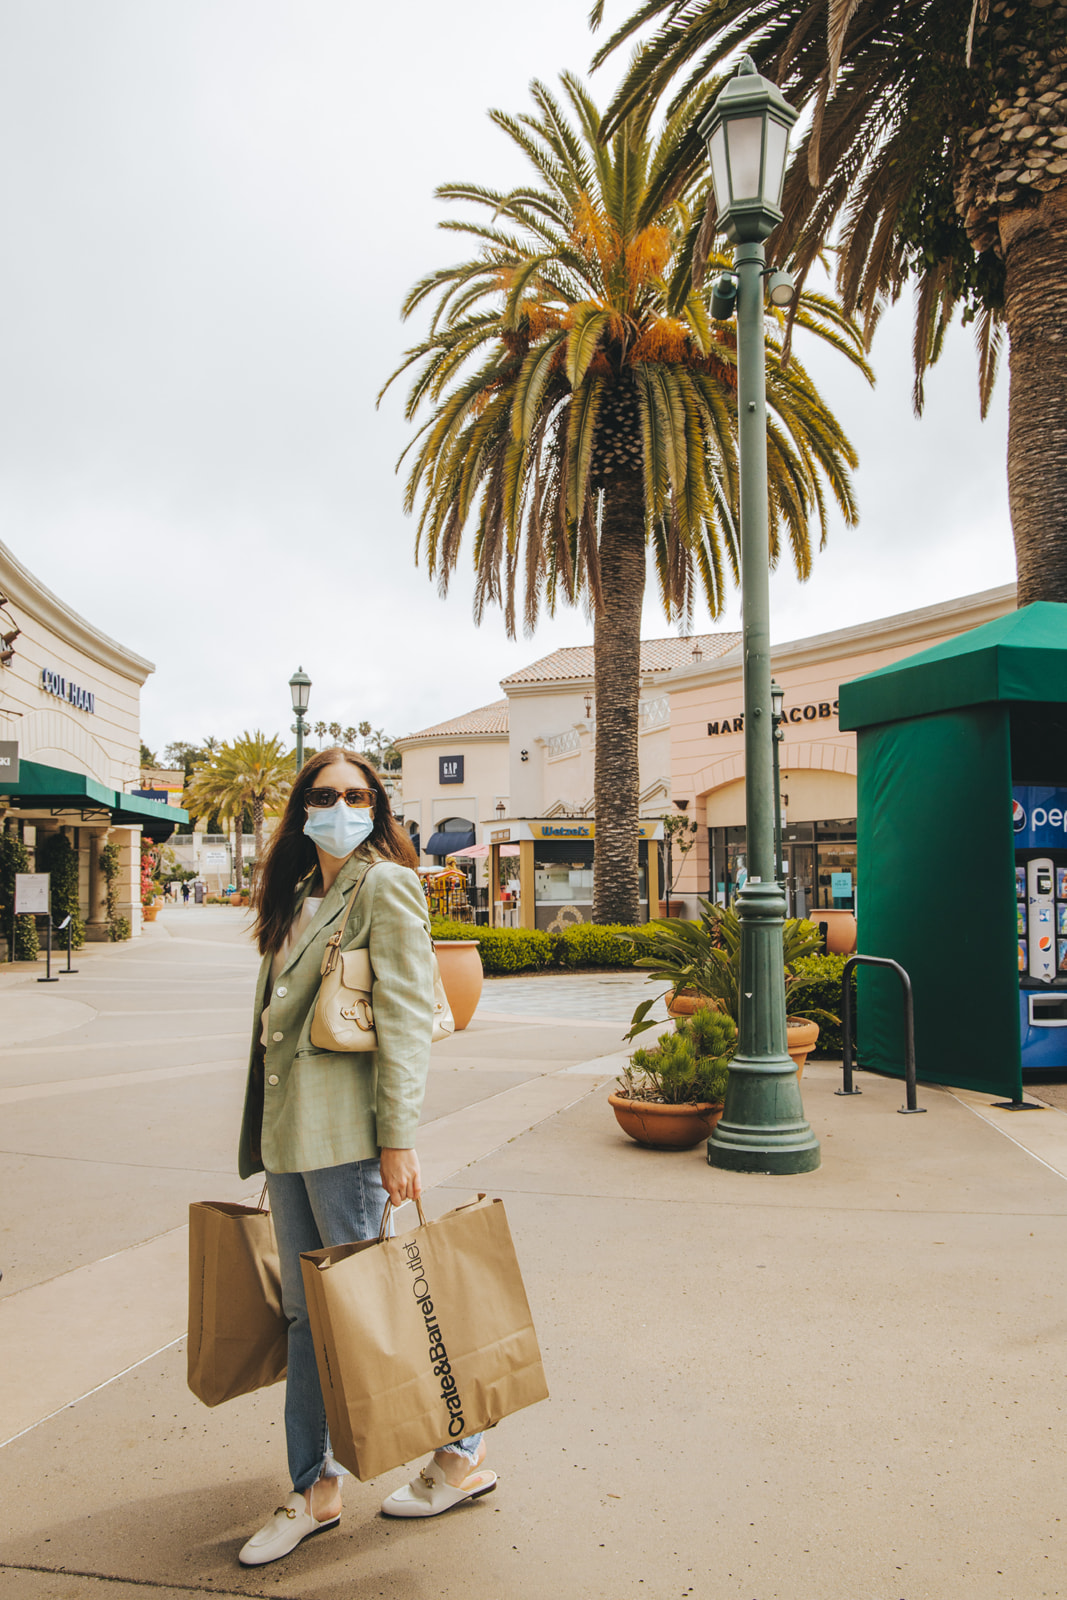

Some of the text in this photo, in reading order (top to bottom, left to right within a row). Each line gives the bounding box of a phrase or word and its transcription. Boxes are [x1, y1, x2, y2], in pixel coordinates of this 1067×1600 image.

[68, 682, 95, 714] HAAN
[707, 700, 839, 736] MAR ACOBS
[443, 762, 458, 775] GAP
[541, 826, 590, 836] Wetzel's
[1031, 807, 1067, 833] pe
